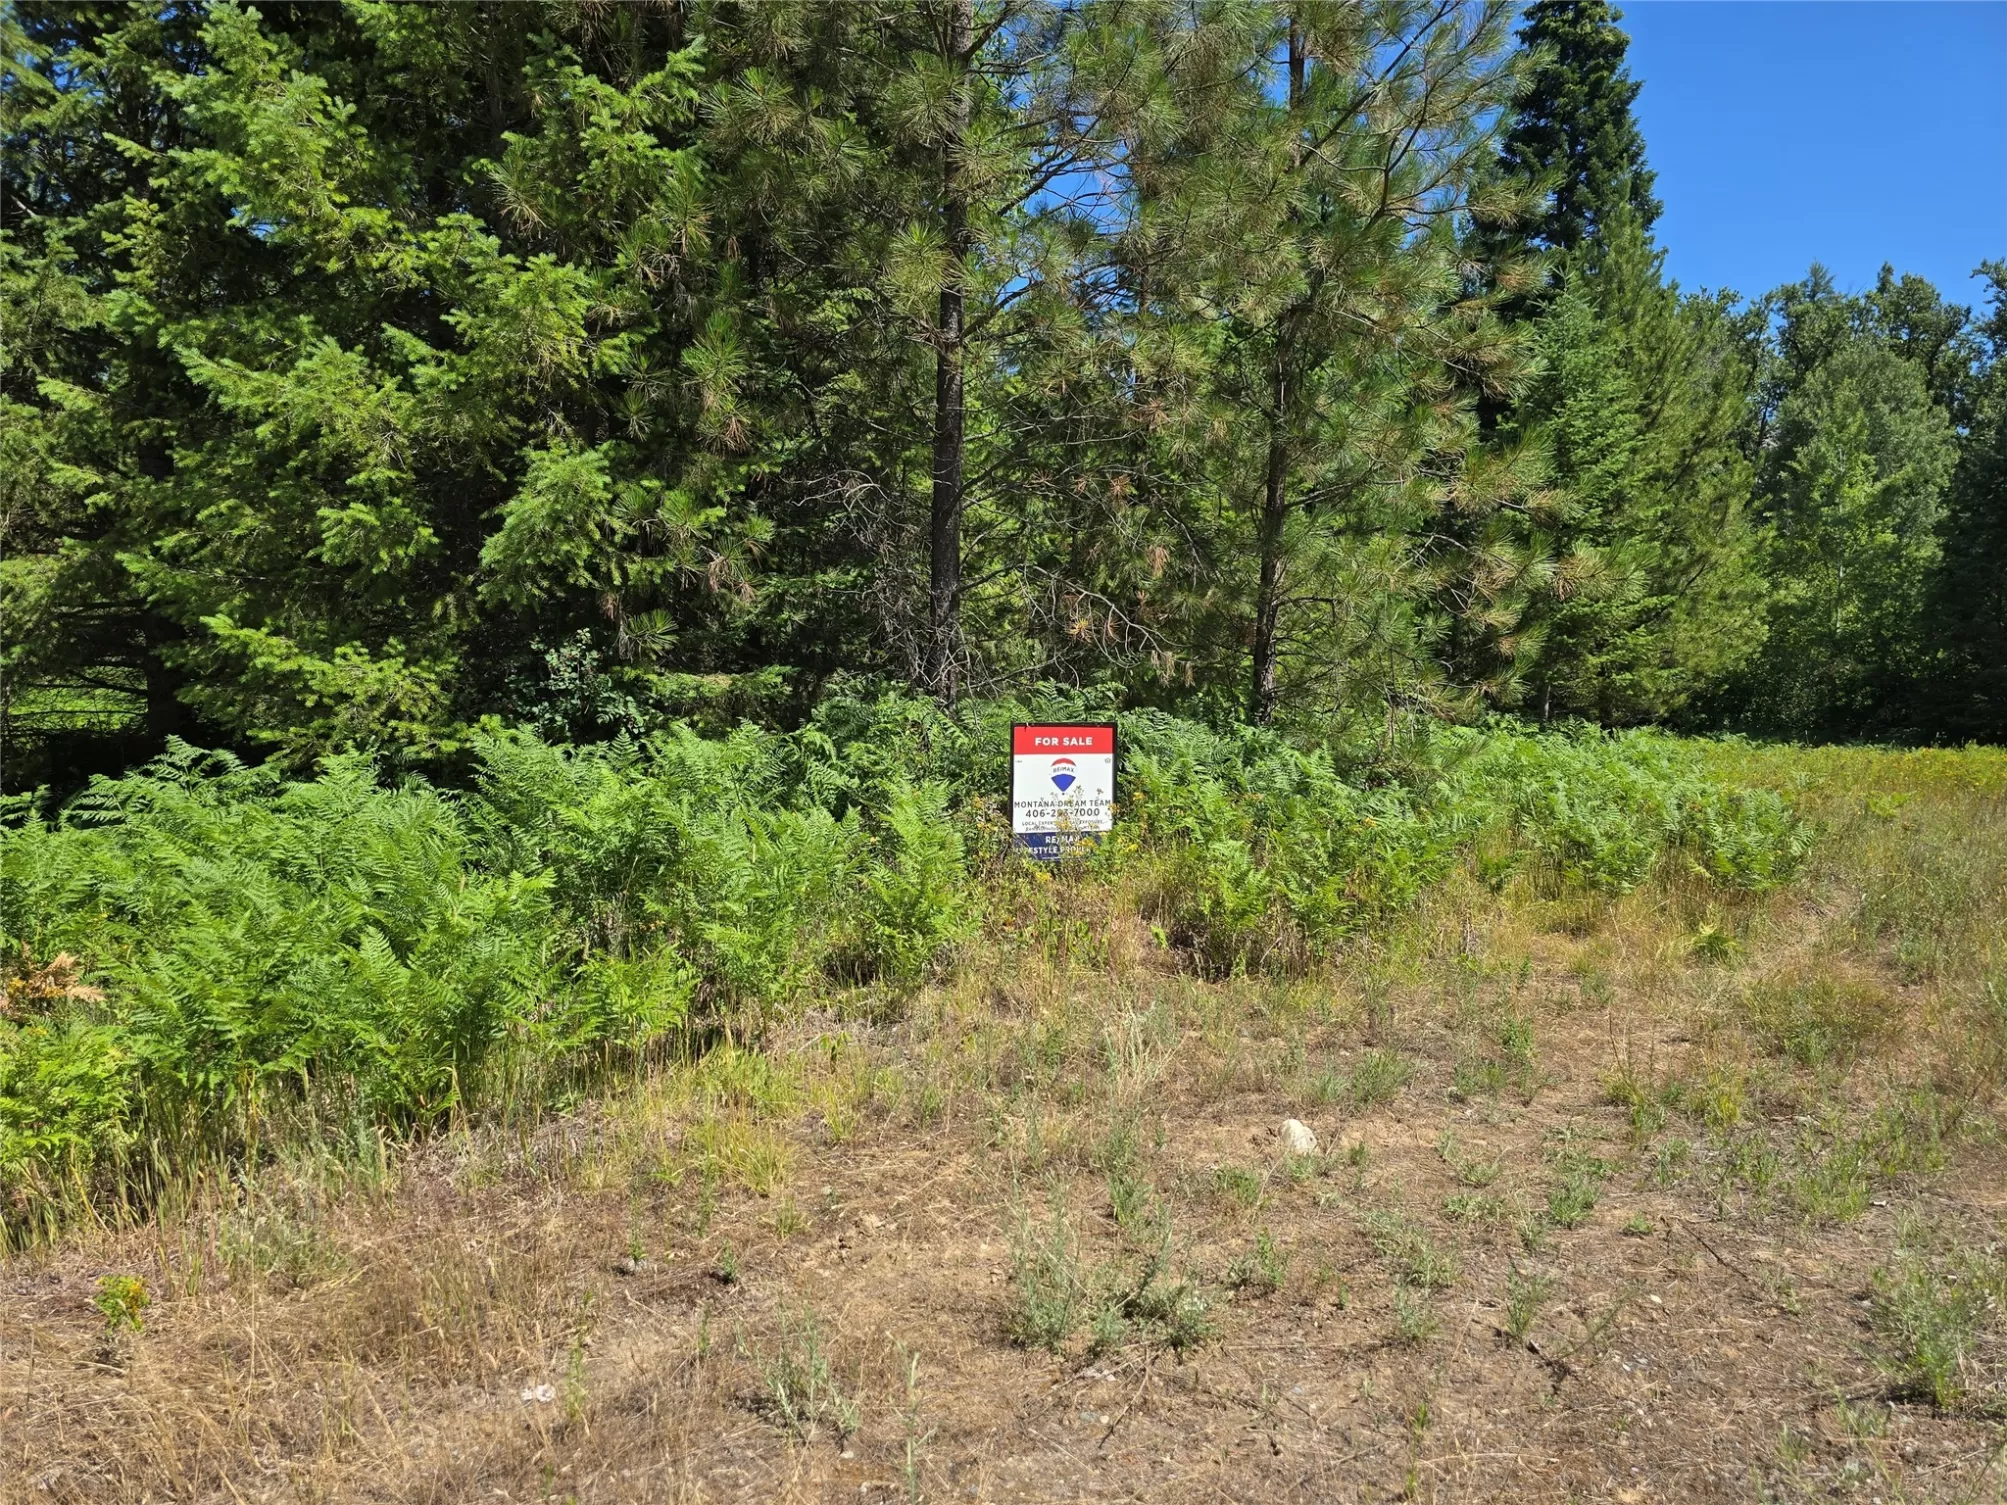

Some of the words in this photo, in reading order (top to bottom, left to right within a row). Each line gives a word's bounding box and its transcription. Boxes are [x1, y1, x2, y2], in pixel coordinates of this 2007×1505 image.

[1034, 737, 1059, 746] FOR
[1063, 737, 1093, 746] SALE
[1014, 800, 1055, 808] MONTANA
[1057, 800, 1087, 808] DREAM
[1090, 799, 1111, 807] TEAM
